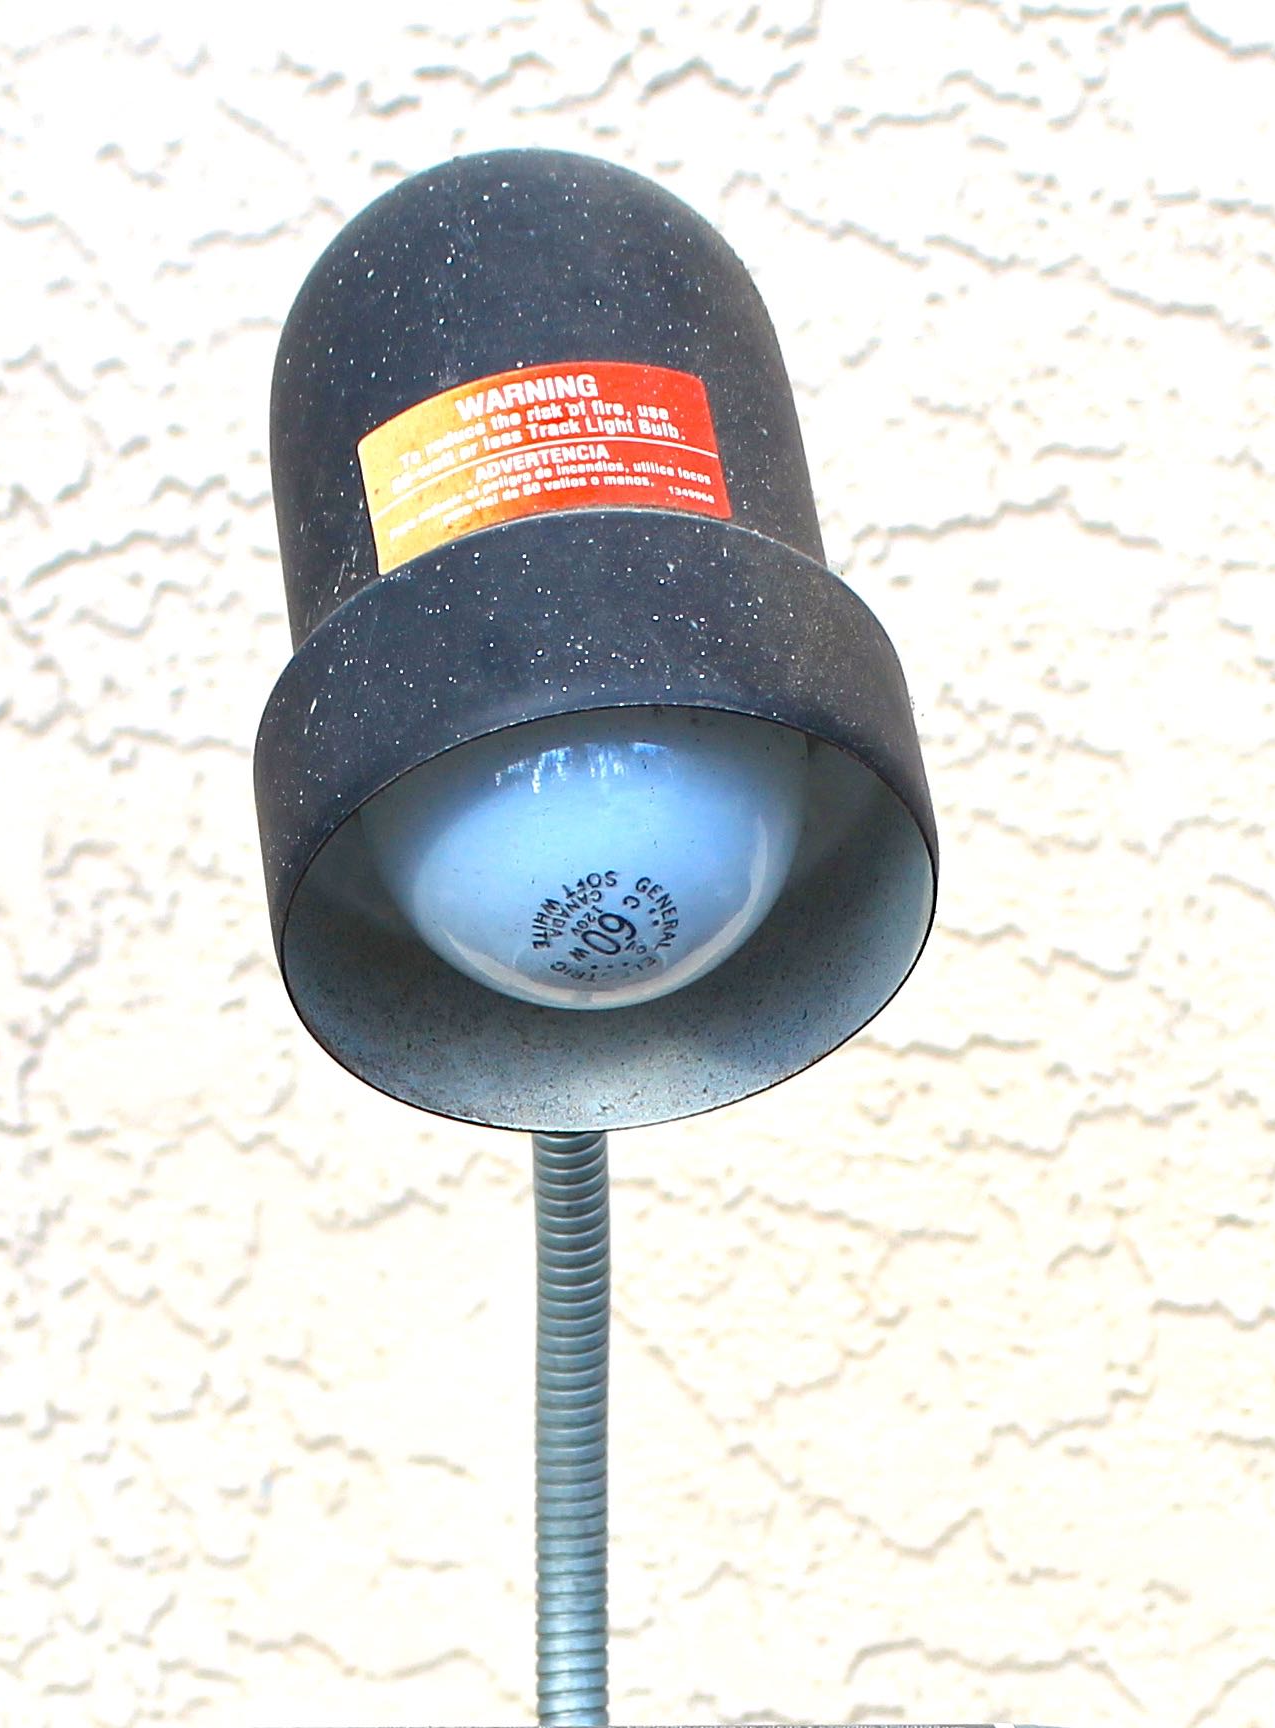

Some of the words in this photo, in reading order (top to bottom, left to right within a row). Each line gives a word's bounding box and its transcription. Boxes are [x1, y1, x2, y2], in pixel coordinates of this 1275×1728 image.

[455, 374, 598, 421] WARNING
[491, 413, 521, 430] the
[526, 403, 563, 422] risk
[567, 401, 585, 417] of
[637, 405, 669, 420] use
[483, 431, 522, 450] less
[526, 418, 581, 440] Track
[585, 417, 634, 435] Light
[638, 418, 685, 440] Bulb.
[476, 444, 610, 483] ADVERTENCIA
[562, 870, 617, 899] SOFT
[532, 898, 560, 949] WHITE
[550, 890, 602, 937] CANADA
[571, 905, 603, 936] 120V
[635, 877, 679, 950] GENERAL
[581, 912, 637, 955] 60
[569, 947, 590, 961] W
